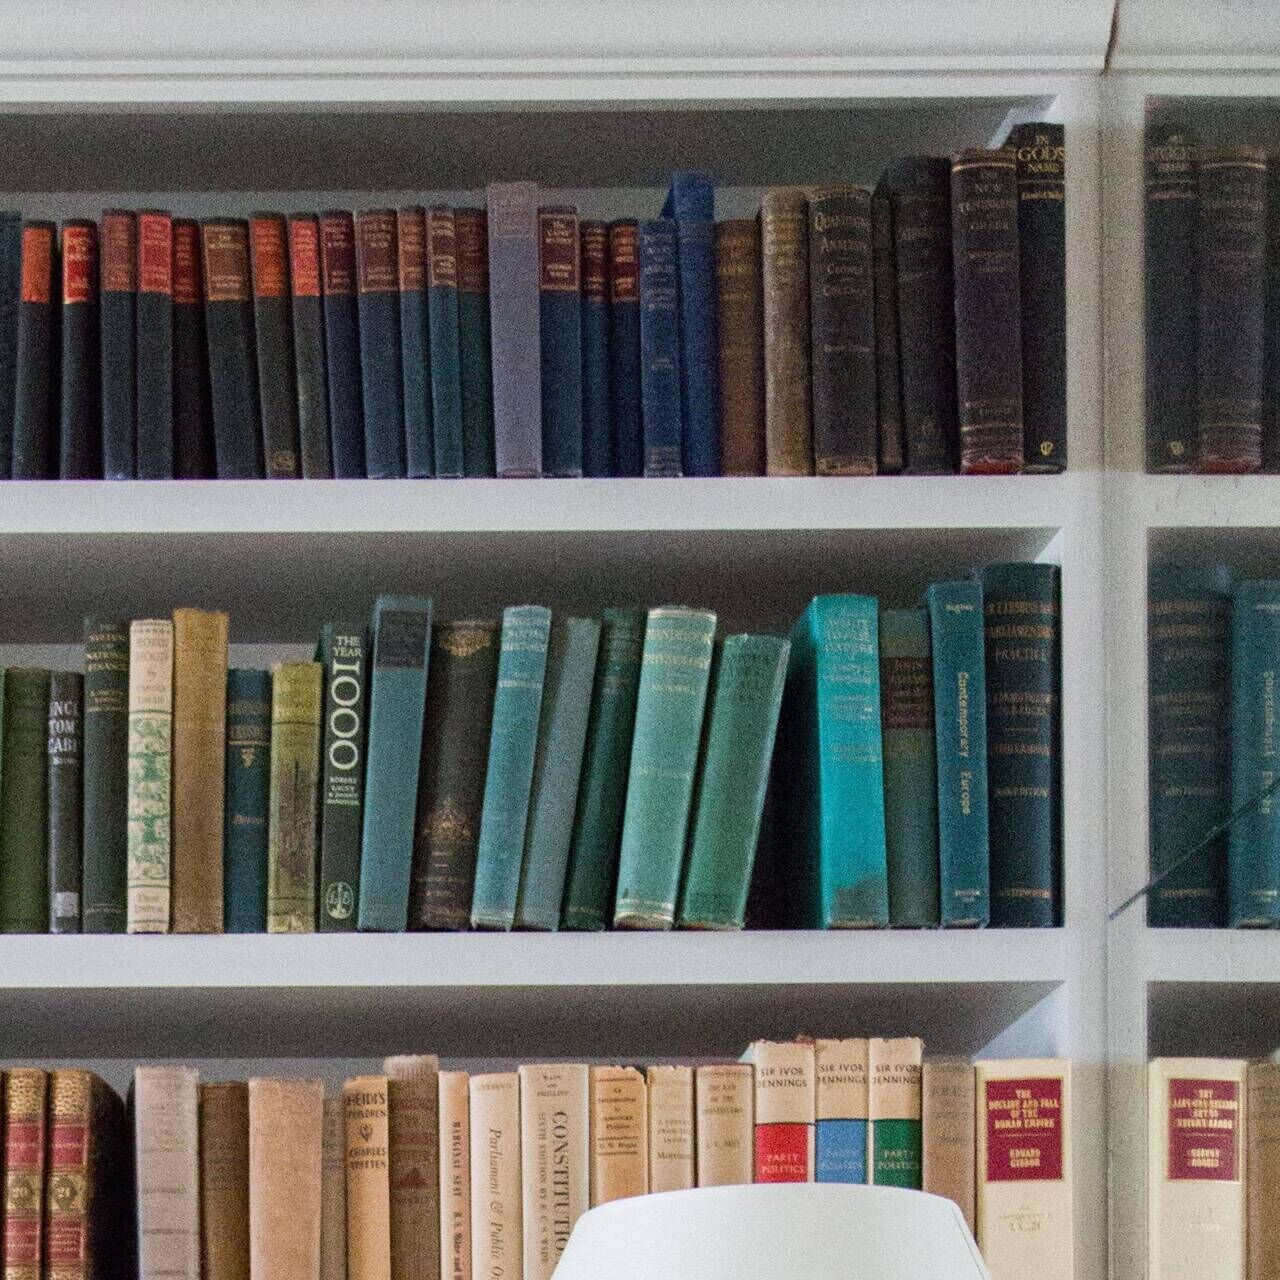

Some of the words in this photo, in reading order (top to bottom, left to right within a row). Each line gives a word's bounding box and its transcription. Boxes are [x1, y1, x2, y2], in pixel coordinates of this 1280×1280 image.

[336, 636, 361, 647] THE
[333, 647, 363, 658] YEAR
[957, 671, 970, 758] Contemporary
[959, 769, 971, 816] Europe
[760, 1068, 776, 1077] SIR
[779, 1067, 805, 1076] IVOR
[820, 1064, 835, 1073] SIR
[839, 1063, 864, 1072] IVOR
[875, 1065, 891, 1073] SIR
[894, 1064, 922, 1073] IVOR
[756, 1078, 808, 1089] JENNINGS
[346, 1092, 386, 1106] HEIDI'S
[1015, 1089, 1032, 1098] THE
[988, 1100, 1021, 1110] DECLINE
[1023, 1099, 1039, 1110] AND
[1040, 1098, 1059, 1108] FALL
[1010, 1109, 1020, 1118] OF
[1023, 1109, 1039, 1118] THE
[994, 1119, 1022, 1129] ROMAN
[1024, 1118, 1055, 1129] EMPIRE
[349, 1147, 387, 1158] CHARLES
[767, 1153, 799, 1163] PARTY
[883, 1149, 914, 1158] PARTY
[1009, 1148, 1041, 1158] EDWARD
[489, 1128, 503, 1195] Parliament
[538, 1144, 547, 1183] EDITION
[762, 1164, 805, 1175] POLITICS
[452, 1175, 462, 1198] SEAT
[552, 1111, 571, 1260] CONSTITUTIO
[490, 1201, 504, 1215] &
[490, 1222, 505, 1259] Public
